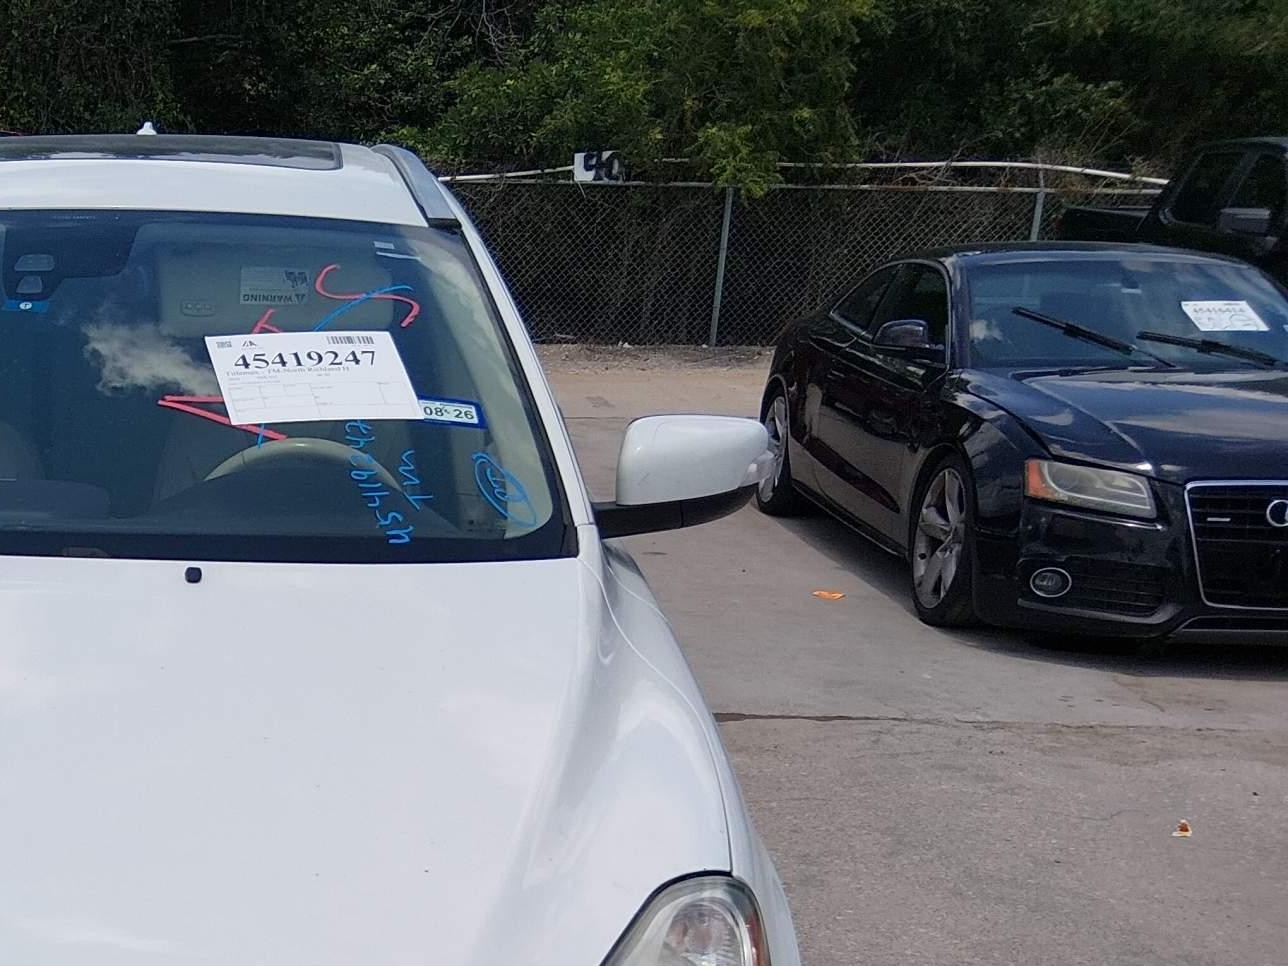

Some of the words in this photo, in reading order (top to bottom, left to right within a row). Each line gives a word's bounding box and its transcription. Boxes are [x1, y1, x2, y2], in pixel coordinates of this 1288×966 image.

[243, 293, 293, 303] WARNING
[234, 350, 375, 369] 45419247
[453, 409, 474, 420] 26
